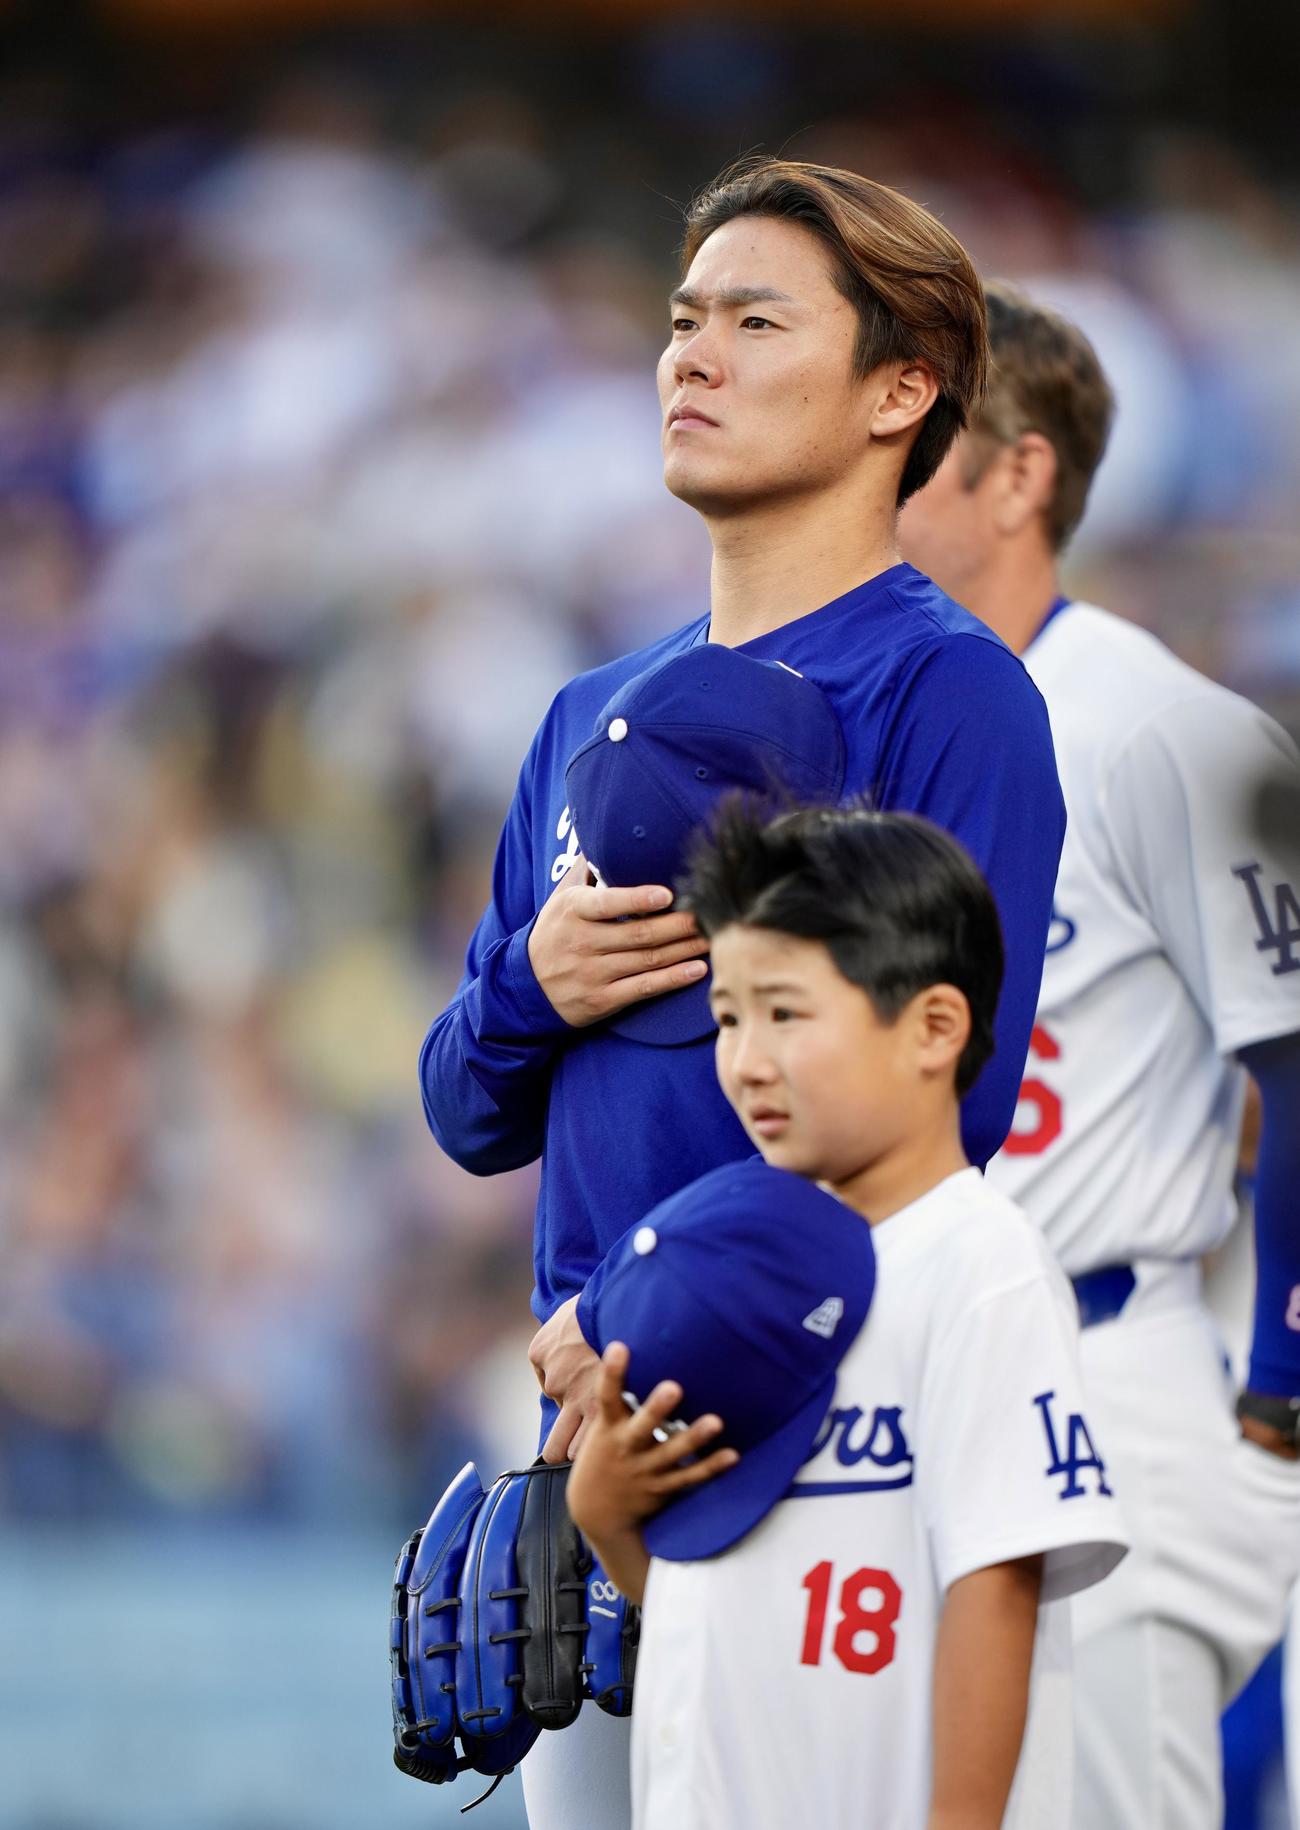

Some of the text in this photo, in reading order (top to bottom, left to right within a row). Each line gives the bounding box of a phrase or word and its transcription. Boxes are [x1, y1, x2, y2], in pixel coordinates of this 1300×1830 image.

[1033, 1389, 1114, 1500] LA
[589, 1580, 620, 1619] 18
[800, 1560, 903, 1676] 18
